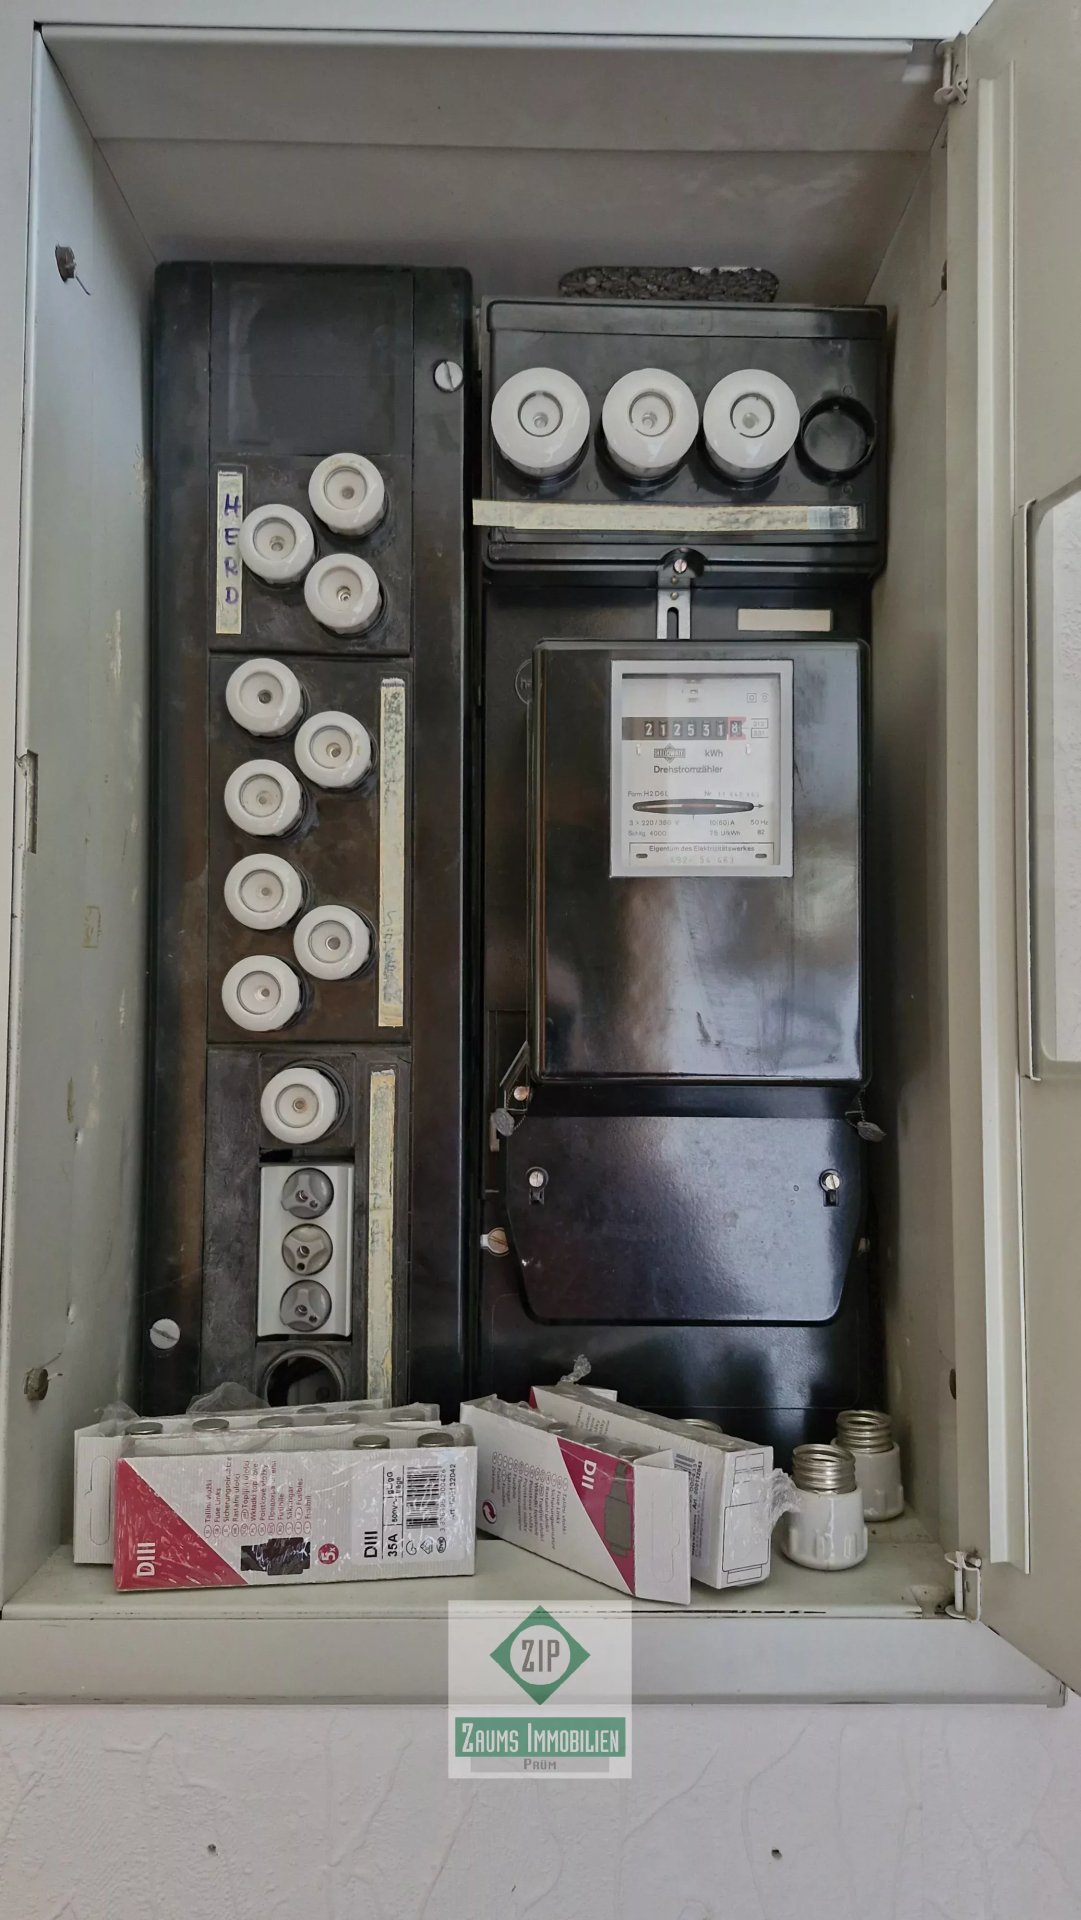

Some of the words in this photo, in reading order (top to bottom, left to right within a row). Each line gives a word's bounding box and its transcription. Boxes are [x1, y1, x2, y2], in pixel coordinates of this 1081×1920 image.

[224, 493, 242, 605] HERD
[705, 749, 724, 758] kWh
[653, 765, 723, 774] Drehstromzähler
[581, 1459, 597, 1490] DII
[363, 1531, 379, 1558] DIII
[387, 1533, 398, 1557] 35A
[136, 1541, 155, 1577] DIII
